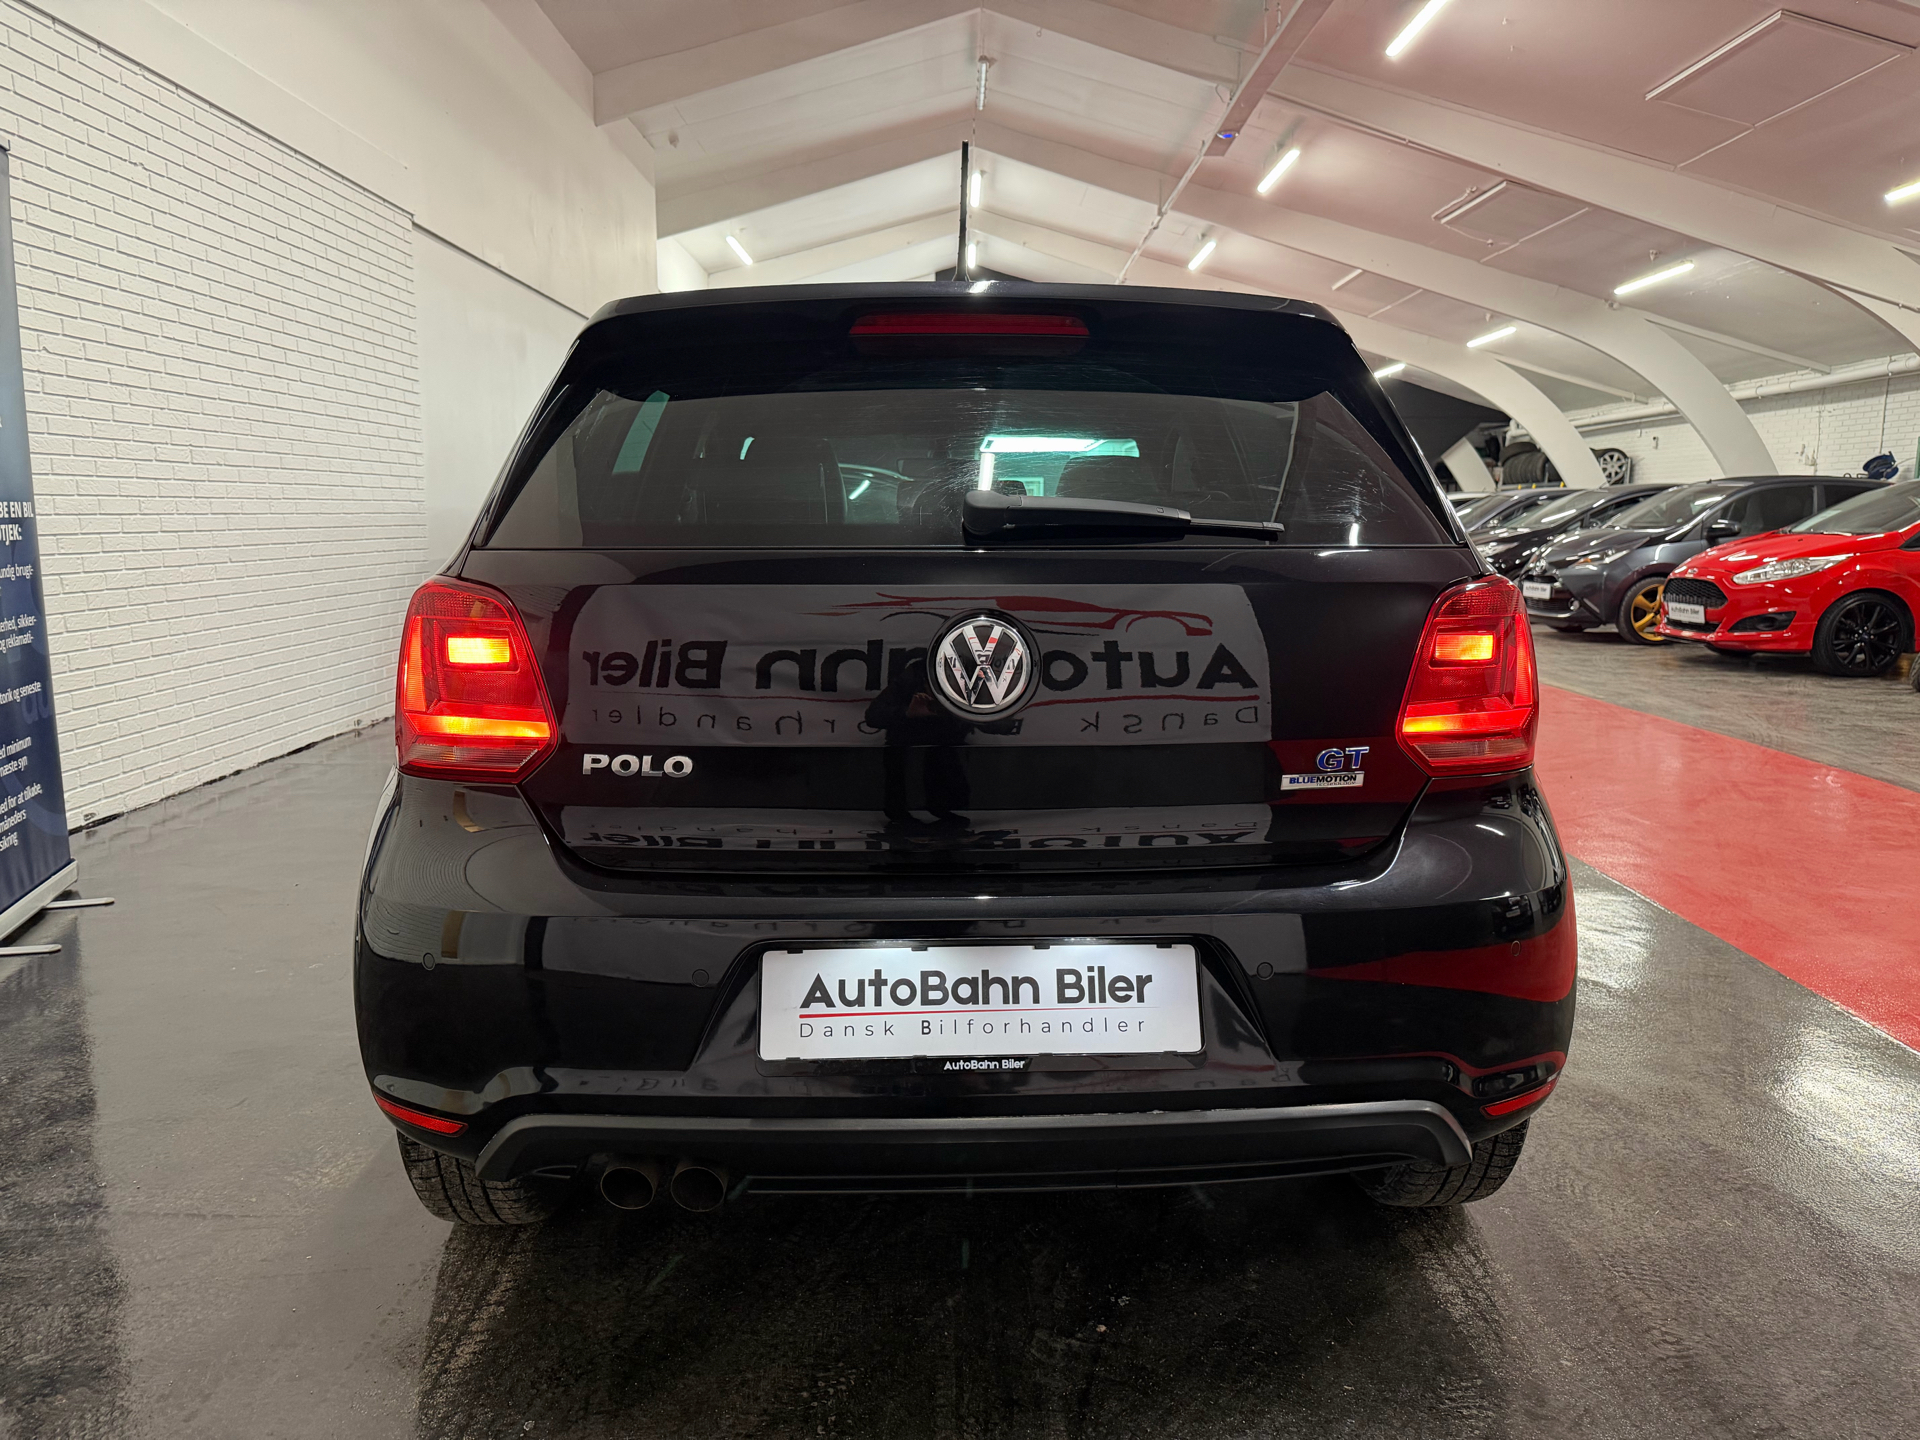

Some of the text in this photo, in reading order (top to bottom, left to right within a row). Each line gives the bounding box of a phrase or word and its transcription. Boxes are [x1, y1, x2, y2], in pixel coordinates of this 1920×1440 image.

[10, 501, 22, 518] EN
[22, 501, 34, 518] BIL
[0, 524, 22, 545] TJEK:
[582, 753, 693, 778] POLO
[1317, 746, 1370, 771] GT
[1289, 774, 1357, 785] BLUEMOTION
[800, 966, 1153, 1009] AutoBahn Biler
[800, 1017, 1145, 1038] Dansk Bilforhandler
[943, 1058, 1026, 1071] AutoBahn Biler
